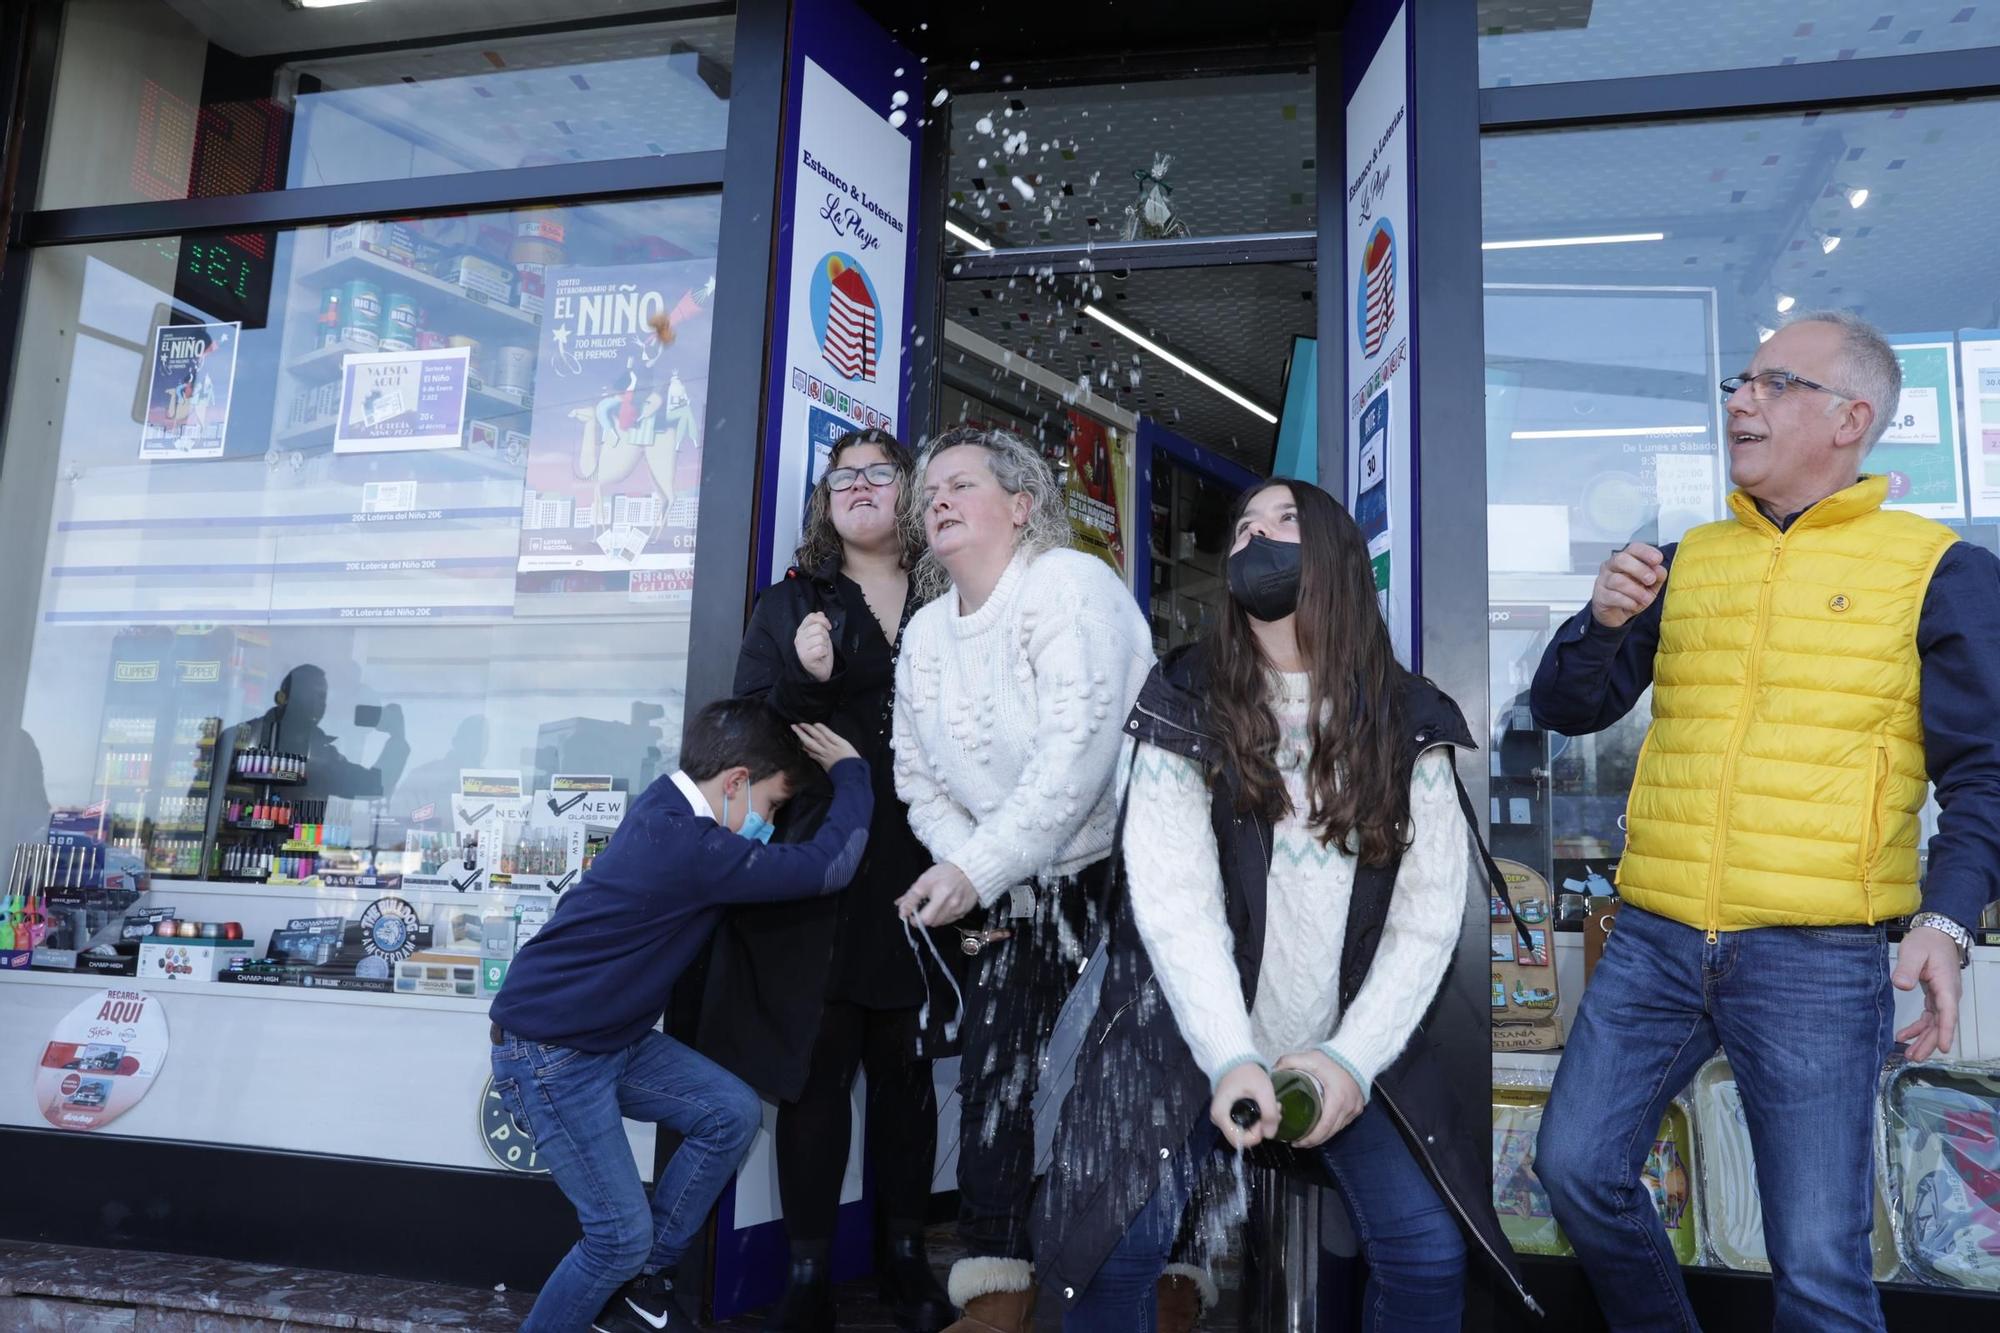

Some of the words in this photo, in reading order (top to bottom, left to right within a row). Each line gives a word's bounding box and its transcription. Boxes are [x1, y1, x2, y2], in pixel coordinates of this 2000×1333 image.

[1349, 159, 1372, 202] Estanco
[1372, 147, 1378, 163] &
[803, 149, 848, 193] Estanco
[850, 185, 859, 202] &
[861, 192, 904, 233] Loterías
[1358, 183, 1372, 227] La
[1370, 164, 1391, 202] Playa
[819, 193, 845, 237] La
[844, 207, 880, 250] Playa
[554, 296, 575, 320] EL
[576, 284, 665, 337] NIÑO
[161, 341, 171, 353] EL
[170, 337, 206, 359] NIÑO
[574, 338, 590, 349] 700
[590, 337, 627, 349] MILLONES
[574, 351, 584, 361] EN
[584, 350, 618, 361] PREMIOS
[424, 375, 431, 383] El
[432, 375, 450, 383] Niño
[419, 412, 430, 421] 20
[1623, 443, 1637, 453] De
[1639, 443, 1670, 453] Lunes
[1366, 454, 1376, 478] 30
[1674, 495, 1702, 506] 14:00
[351, 513, 366, 523] 20€
[394, 511, 407, 521] del
[408, 510, 426, 520] Niño
[427, 510, 443, 519] 20€
[1069, 498, 1078, 509] DE
[1078, 501, 1087, 514] LA
[1088, 505, 1115, 524] NAVIDAD
[673, 535, 681, 549] 6
[346, 563, 360, 572] 20€
[388, 561, 401, 570] del
[402, 560, 420, 569] Niño
[421, 560, 436, 569] 20€
[340, 608, 355, 618] 20€
[383, 607, 395, 617] del
[396, 607, 415, 617] Niño
[415, 607, 431, 617] 20€
[119, 666, 155, 678] CLIPPER
[582, 802, 622, 813] NEW
[495, 809, 530, 819] NEW
[567, 813, 599, 822] GLASS
[600, 814, 620, 822] PIPE
[360, 905, 381, 930] THE
[378, 898, 419, 933] BULLDOG
[361, 937, 417, 964] AMSTERDAM
[107, 989, 140, 1001] RECARGA
[97, 997, 148, 1025] AQUÍ
